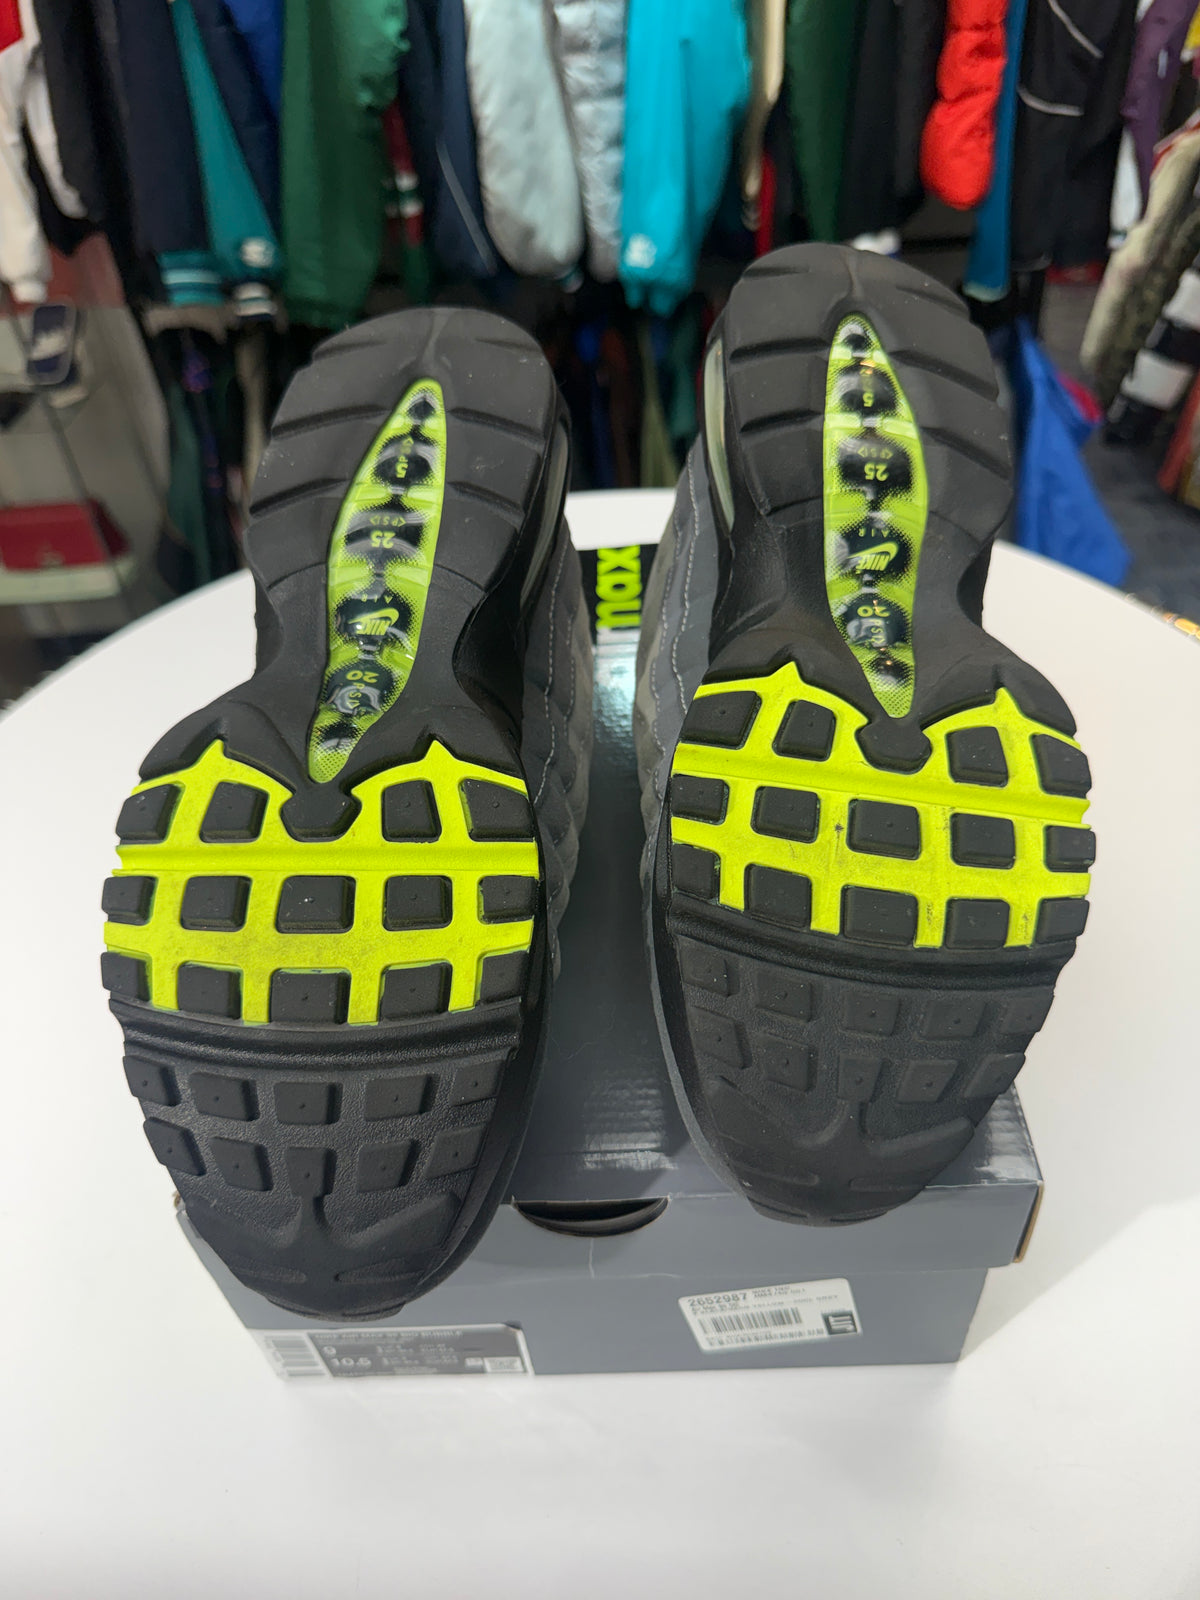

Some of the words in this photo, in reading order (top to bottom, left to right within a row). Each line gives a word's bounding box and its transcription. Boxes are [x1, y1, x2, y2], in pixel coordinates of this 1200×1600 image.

[862, 391, 875, 408] 5
[395, 462, 409, 478] 5
[864, 463, 890, 482] 25
[370, 530, 396, 549] 25
[858, 528, 891, 538] AIR
[855, 554, 891, 571] NIKE
[360, 593, 393, 604] AIR
[857, 605, 891, 618] 20
[354, 619, 391, 636] NIKE
[345, 669, 380, 683] 20
[688, 1293, 748, 1306] 2652987
